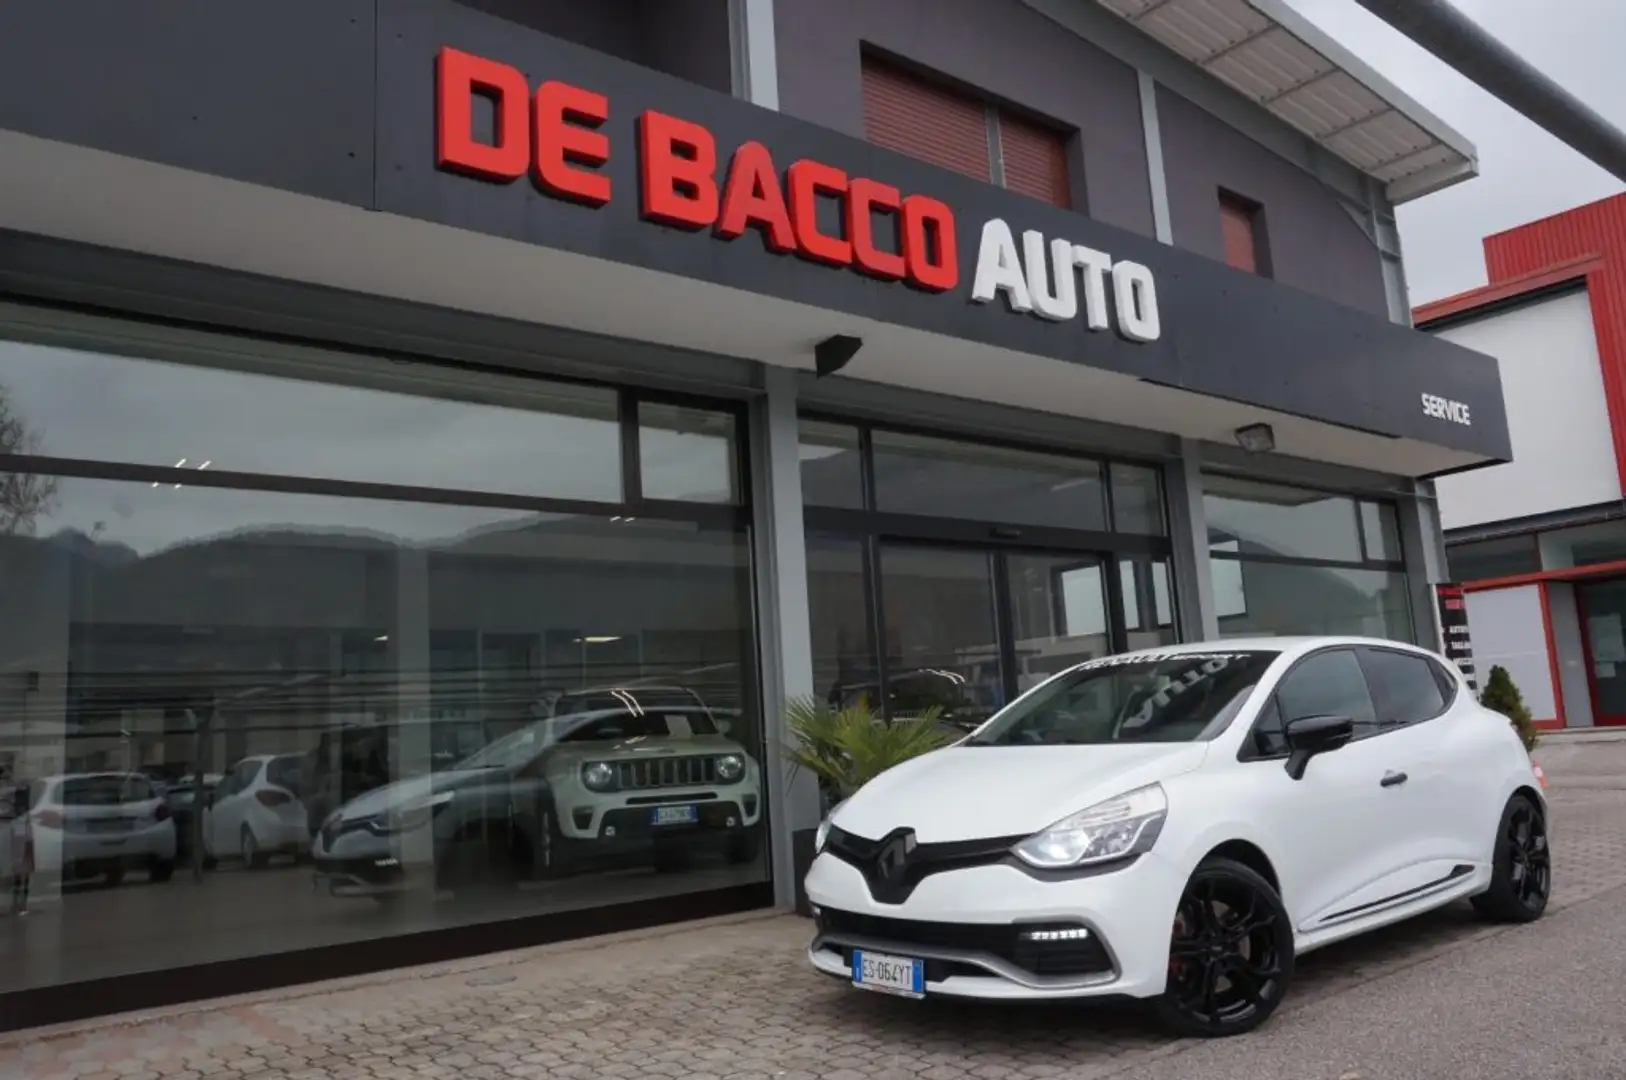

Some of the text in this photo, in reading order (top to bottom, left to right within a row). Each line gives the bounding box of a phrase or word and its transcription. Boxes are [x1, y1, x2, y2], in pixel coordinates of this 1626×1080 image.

[435, 45, 1161, 342] DE BACCO AUTO
[1421, 392, 1471, 426] SERVICE
